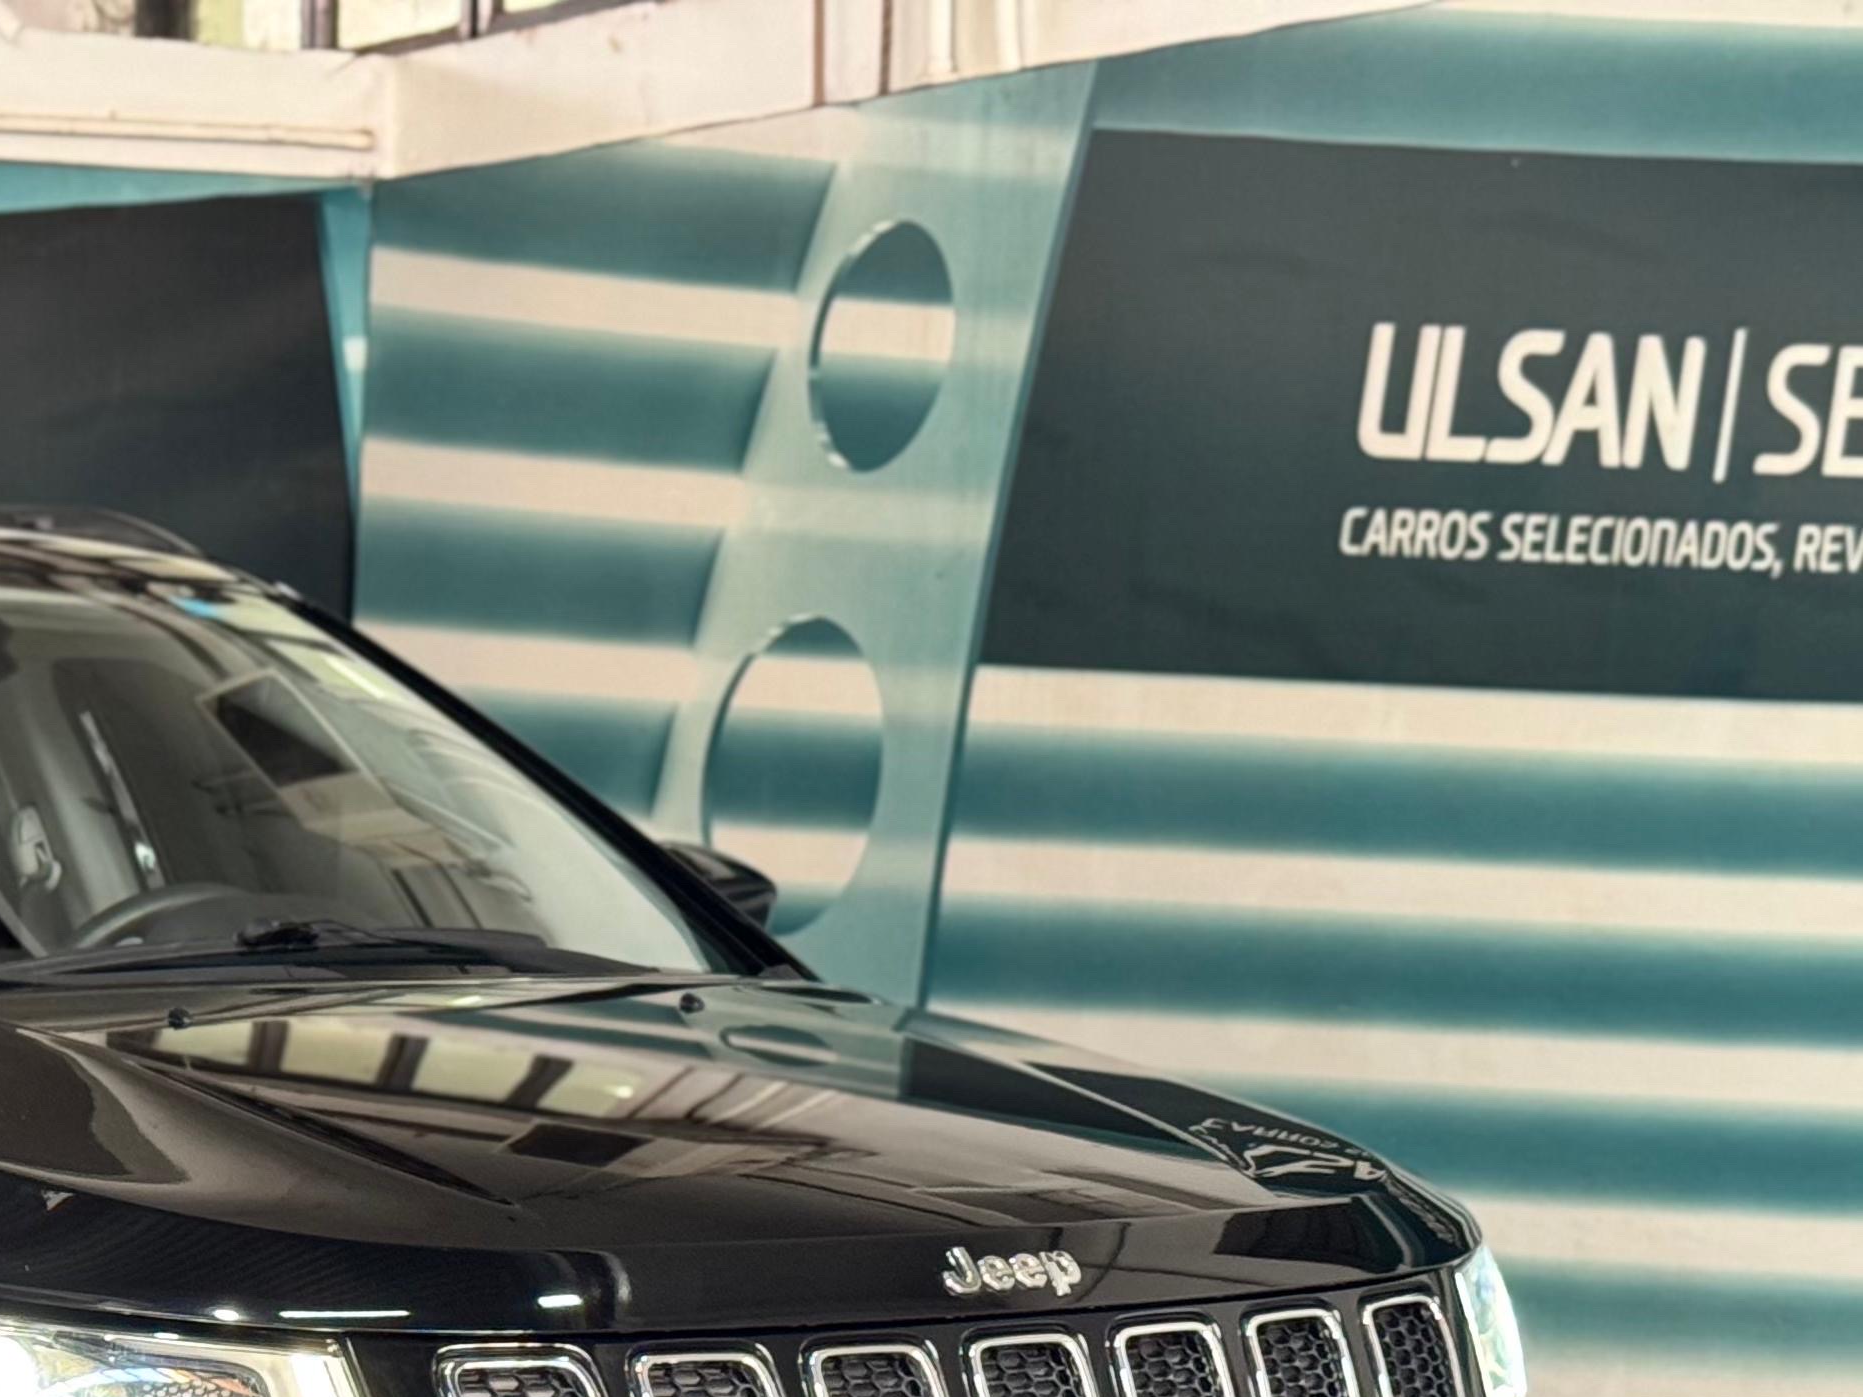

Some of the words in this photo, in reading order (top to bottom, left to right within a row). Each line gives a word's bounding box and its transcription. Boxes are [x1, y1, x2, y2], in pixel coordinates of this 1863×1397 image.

[1357, 322, 1707, 471] ULSAN
[1339, 507, 1493, 559] CARROS
[942, 1246, 1082, 1297] Jeep
